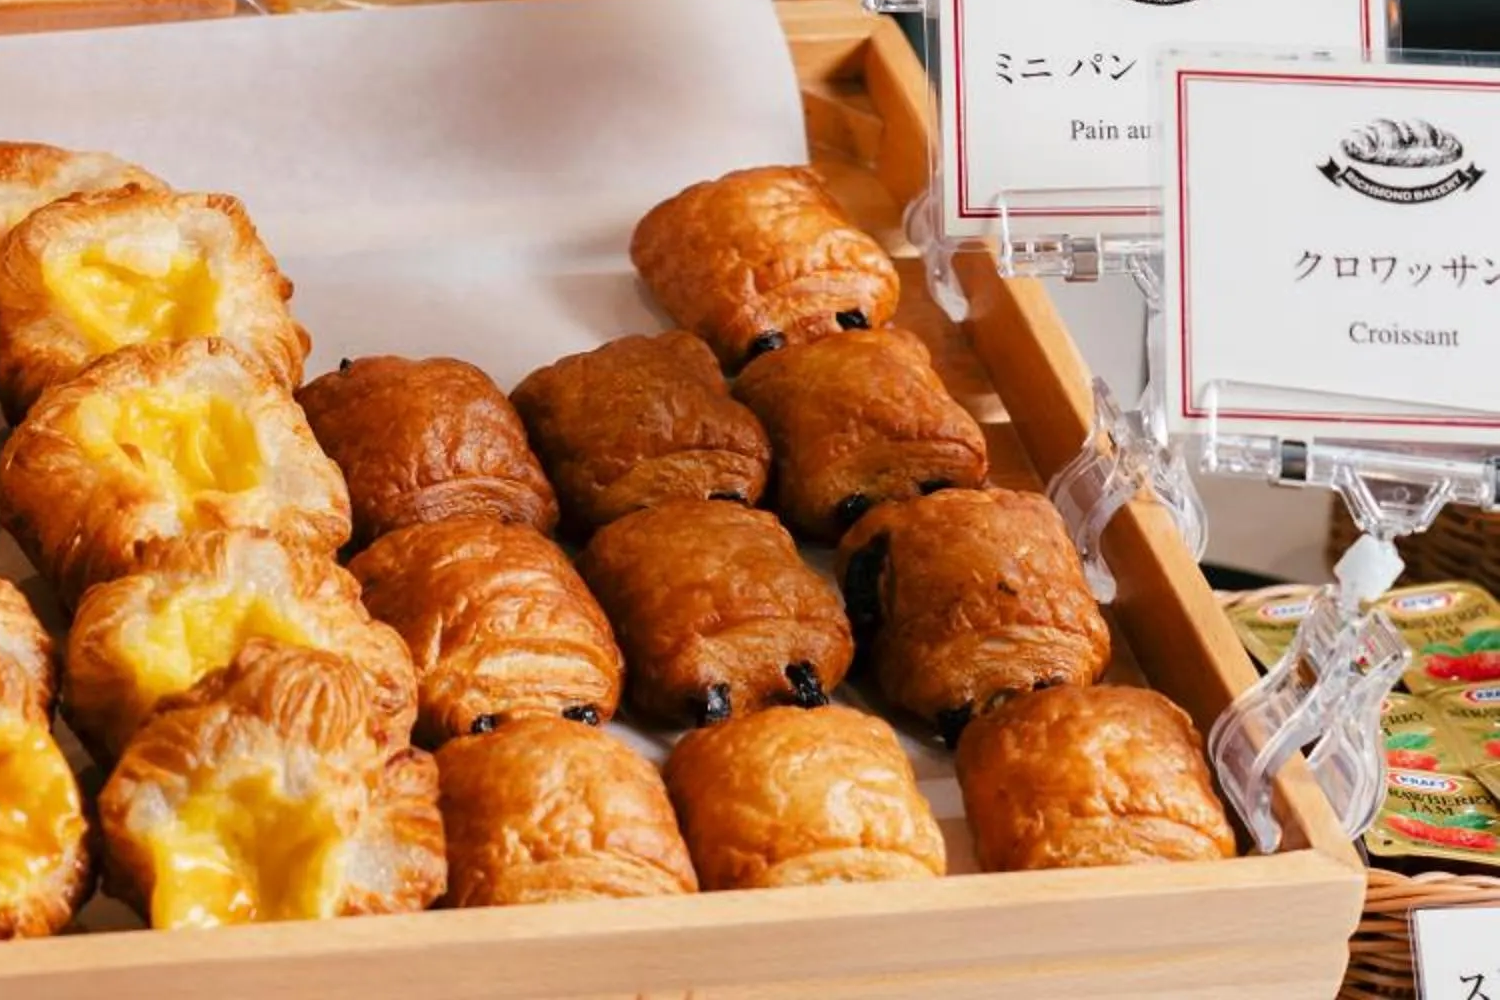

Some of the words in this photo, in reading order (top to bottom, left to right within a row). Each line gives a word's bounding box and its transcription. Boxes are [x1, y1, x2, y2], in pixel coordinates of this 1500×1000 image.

[1070, 119, 1120, 141] Pain
[1127, 125, 1152, 140] au
[1345, 171, 1413, 201] RICHMOND
[1413, 175, 1462, 201] BAKERY
[1348, 322, 1460, 348] Croissant
